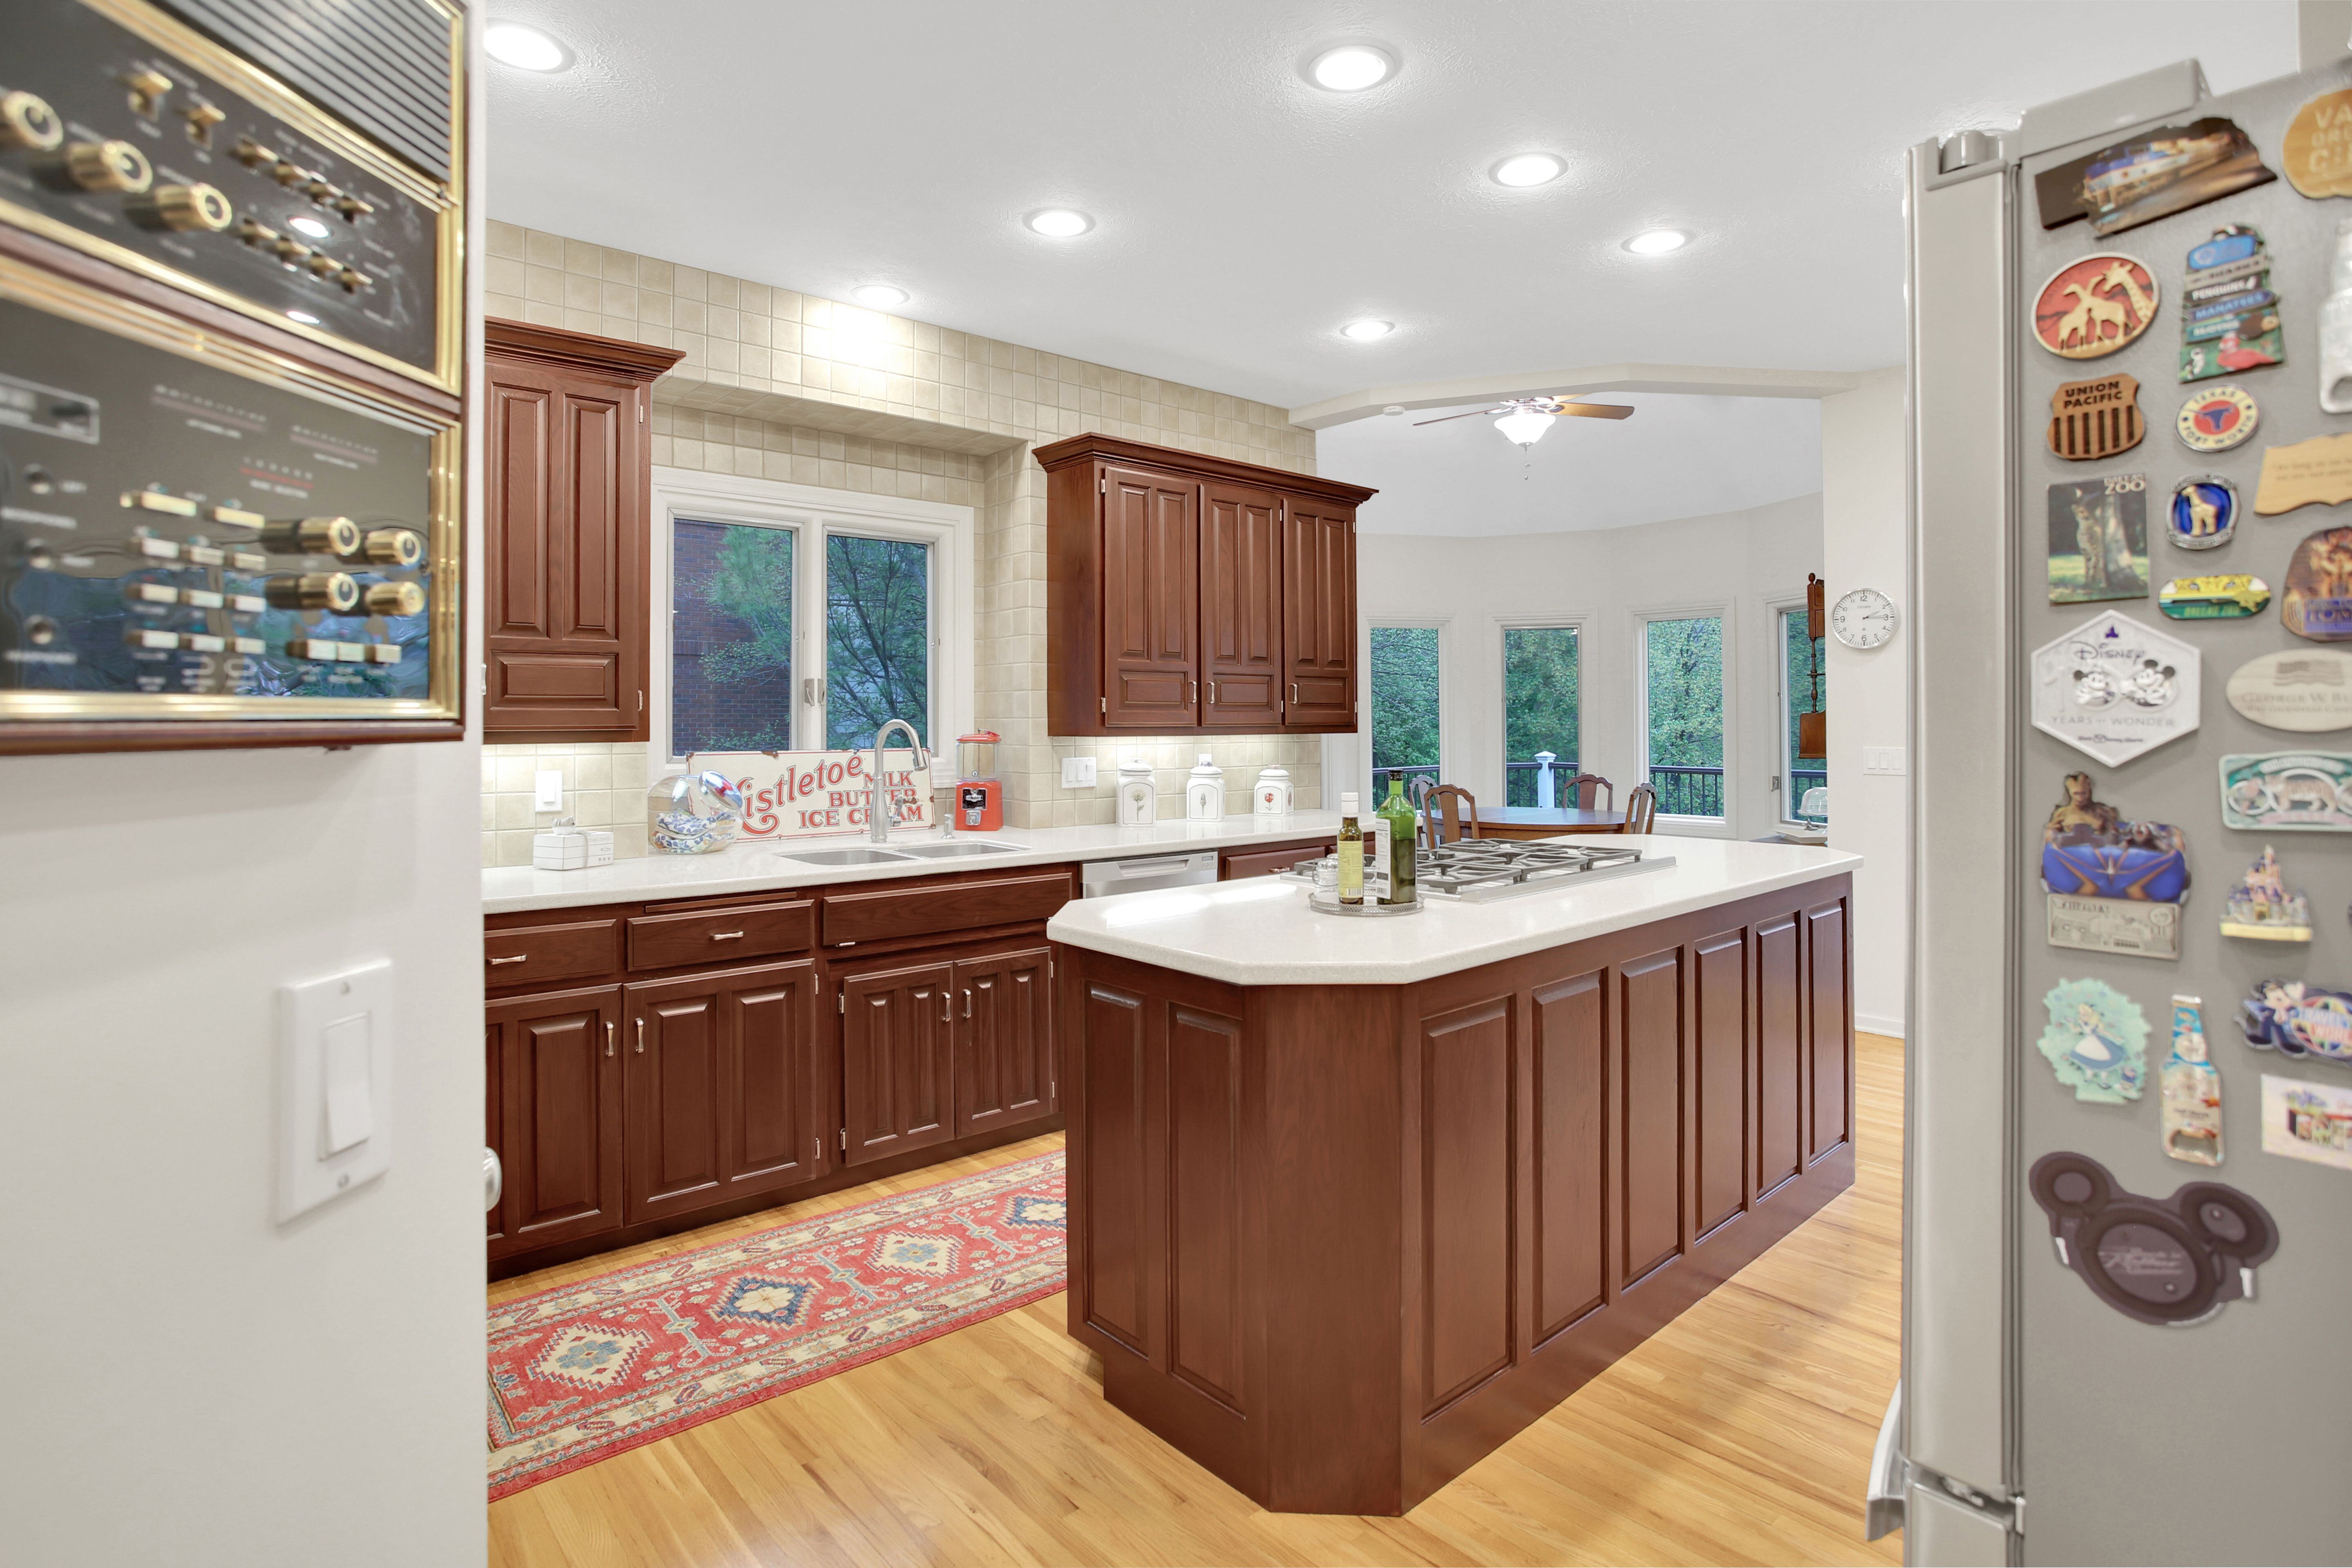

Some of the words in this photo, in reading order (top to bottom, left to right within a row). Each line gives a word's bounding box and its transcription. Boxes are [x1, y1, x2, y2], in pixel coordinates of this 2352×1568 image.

[2195, 292, 2263, 320] MANATEES
[2065, 381, 2119, 397] UNION
[2194, 390, 2236, 404] TEXAS
[2064, 391, 2123, 409] PACIFIC
[2105, 479, 2146, 494] ZOO
[2051, 716, 2092, 725] YEARS
[2110, 717, 2175, 726] WONDER
[736, 755, 863, 835] istletoe
[827, 788, 917, 808] BUTER
[799, 809, 840, 829] ICE
[847, 804, 924, 825] CAM
